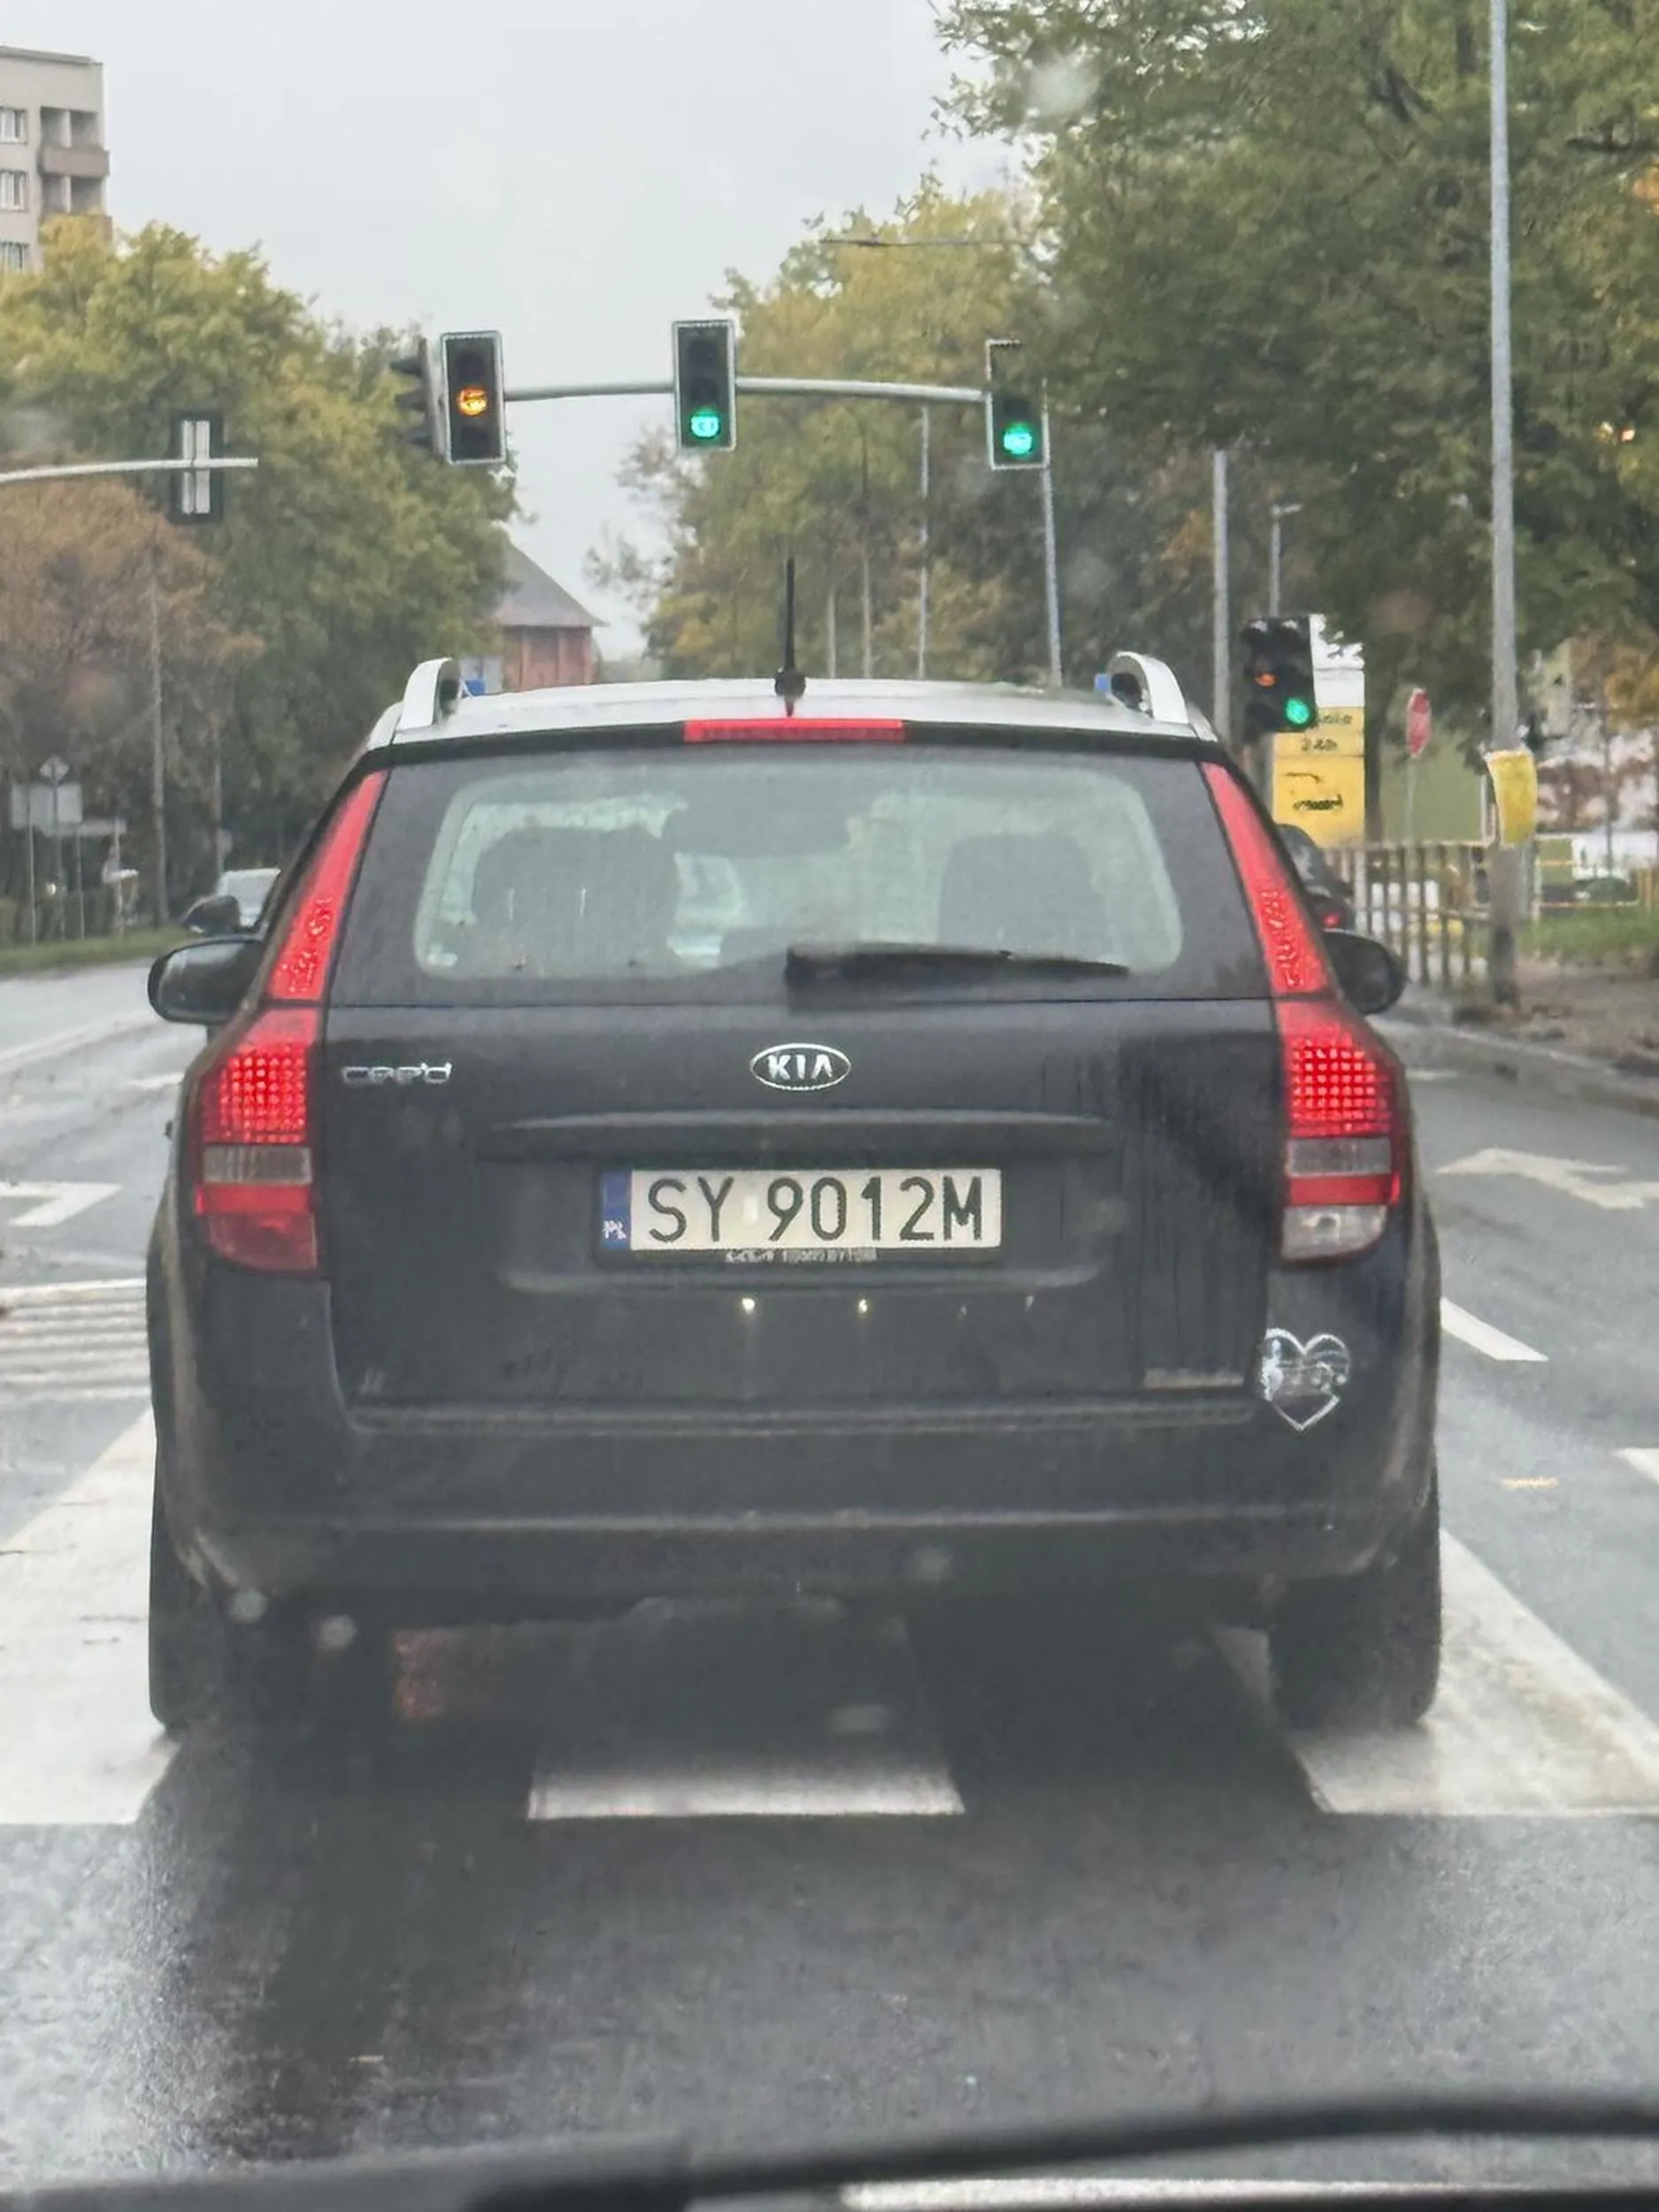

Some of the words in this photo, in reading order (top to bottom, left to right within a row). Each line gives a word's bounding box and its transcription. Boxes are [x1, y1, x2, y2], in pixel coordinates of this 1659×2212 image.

[767, 1054, 833, 1079] KIA
[648, 1177, 734, 1242] SY
[766, 1176, 982, 1241] 9012M
